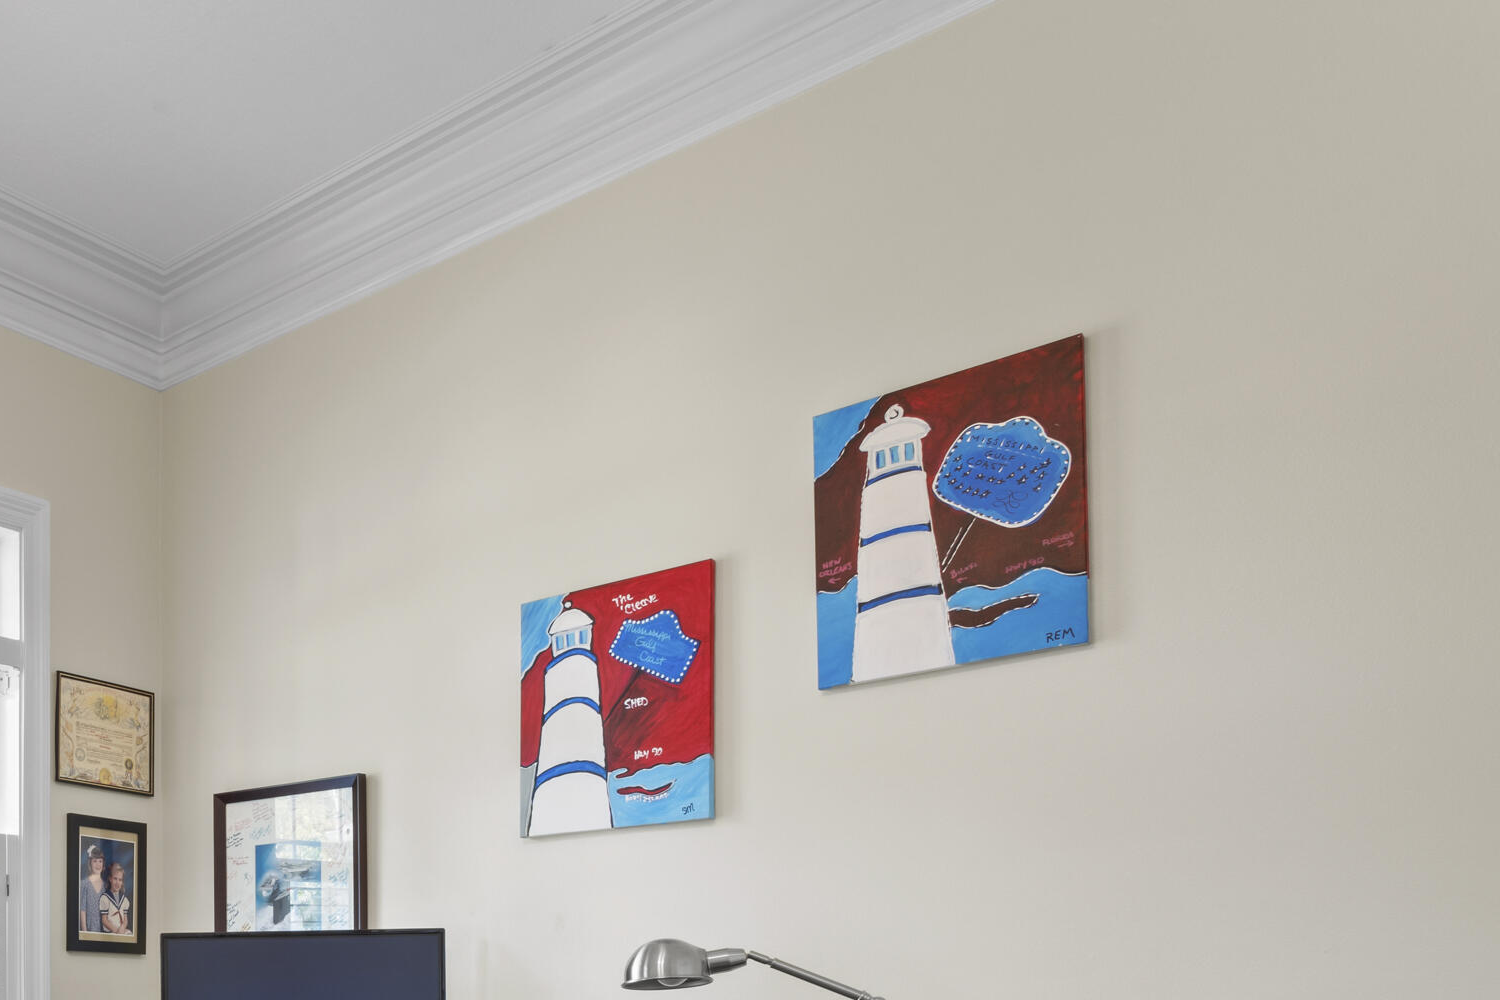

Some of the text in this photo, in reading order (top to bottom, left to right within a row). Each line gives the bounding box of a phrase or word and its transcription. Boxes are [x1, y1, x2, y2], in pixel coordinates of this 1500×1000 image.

[985, 450, 1016, 461] GULF
[966, 457, 1008, 473] COAST
[1046, 627, 1076, 643] REM
[635, 636, 657, 653] Gulf
[639, 650, 668, 665] Coast
[624, 697, 649, 709] SHED
